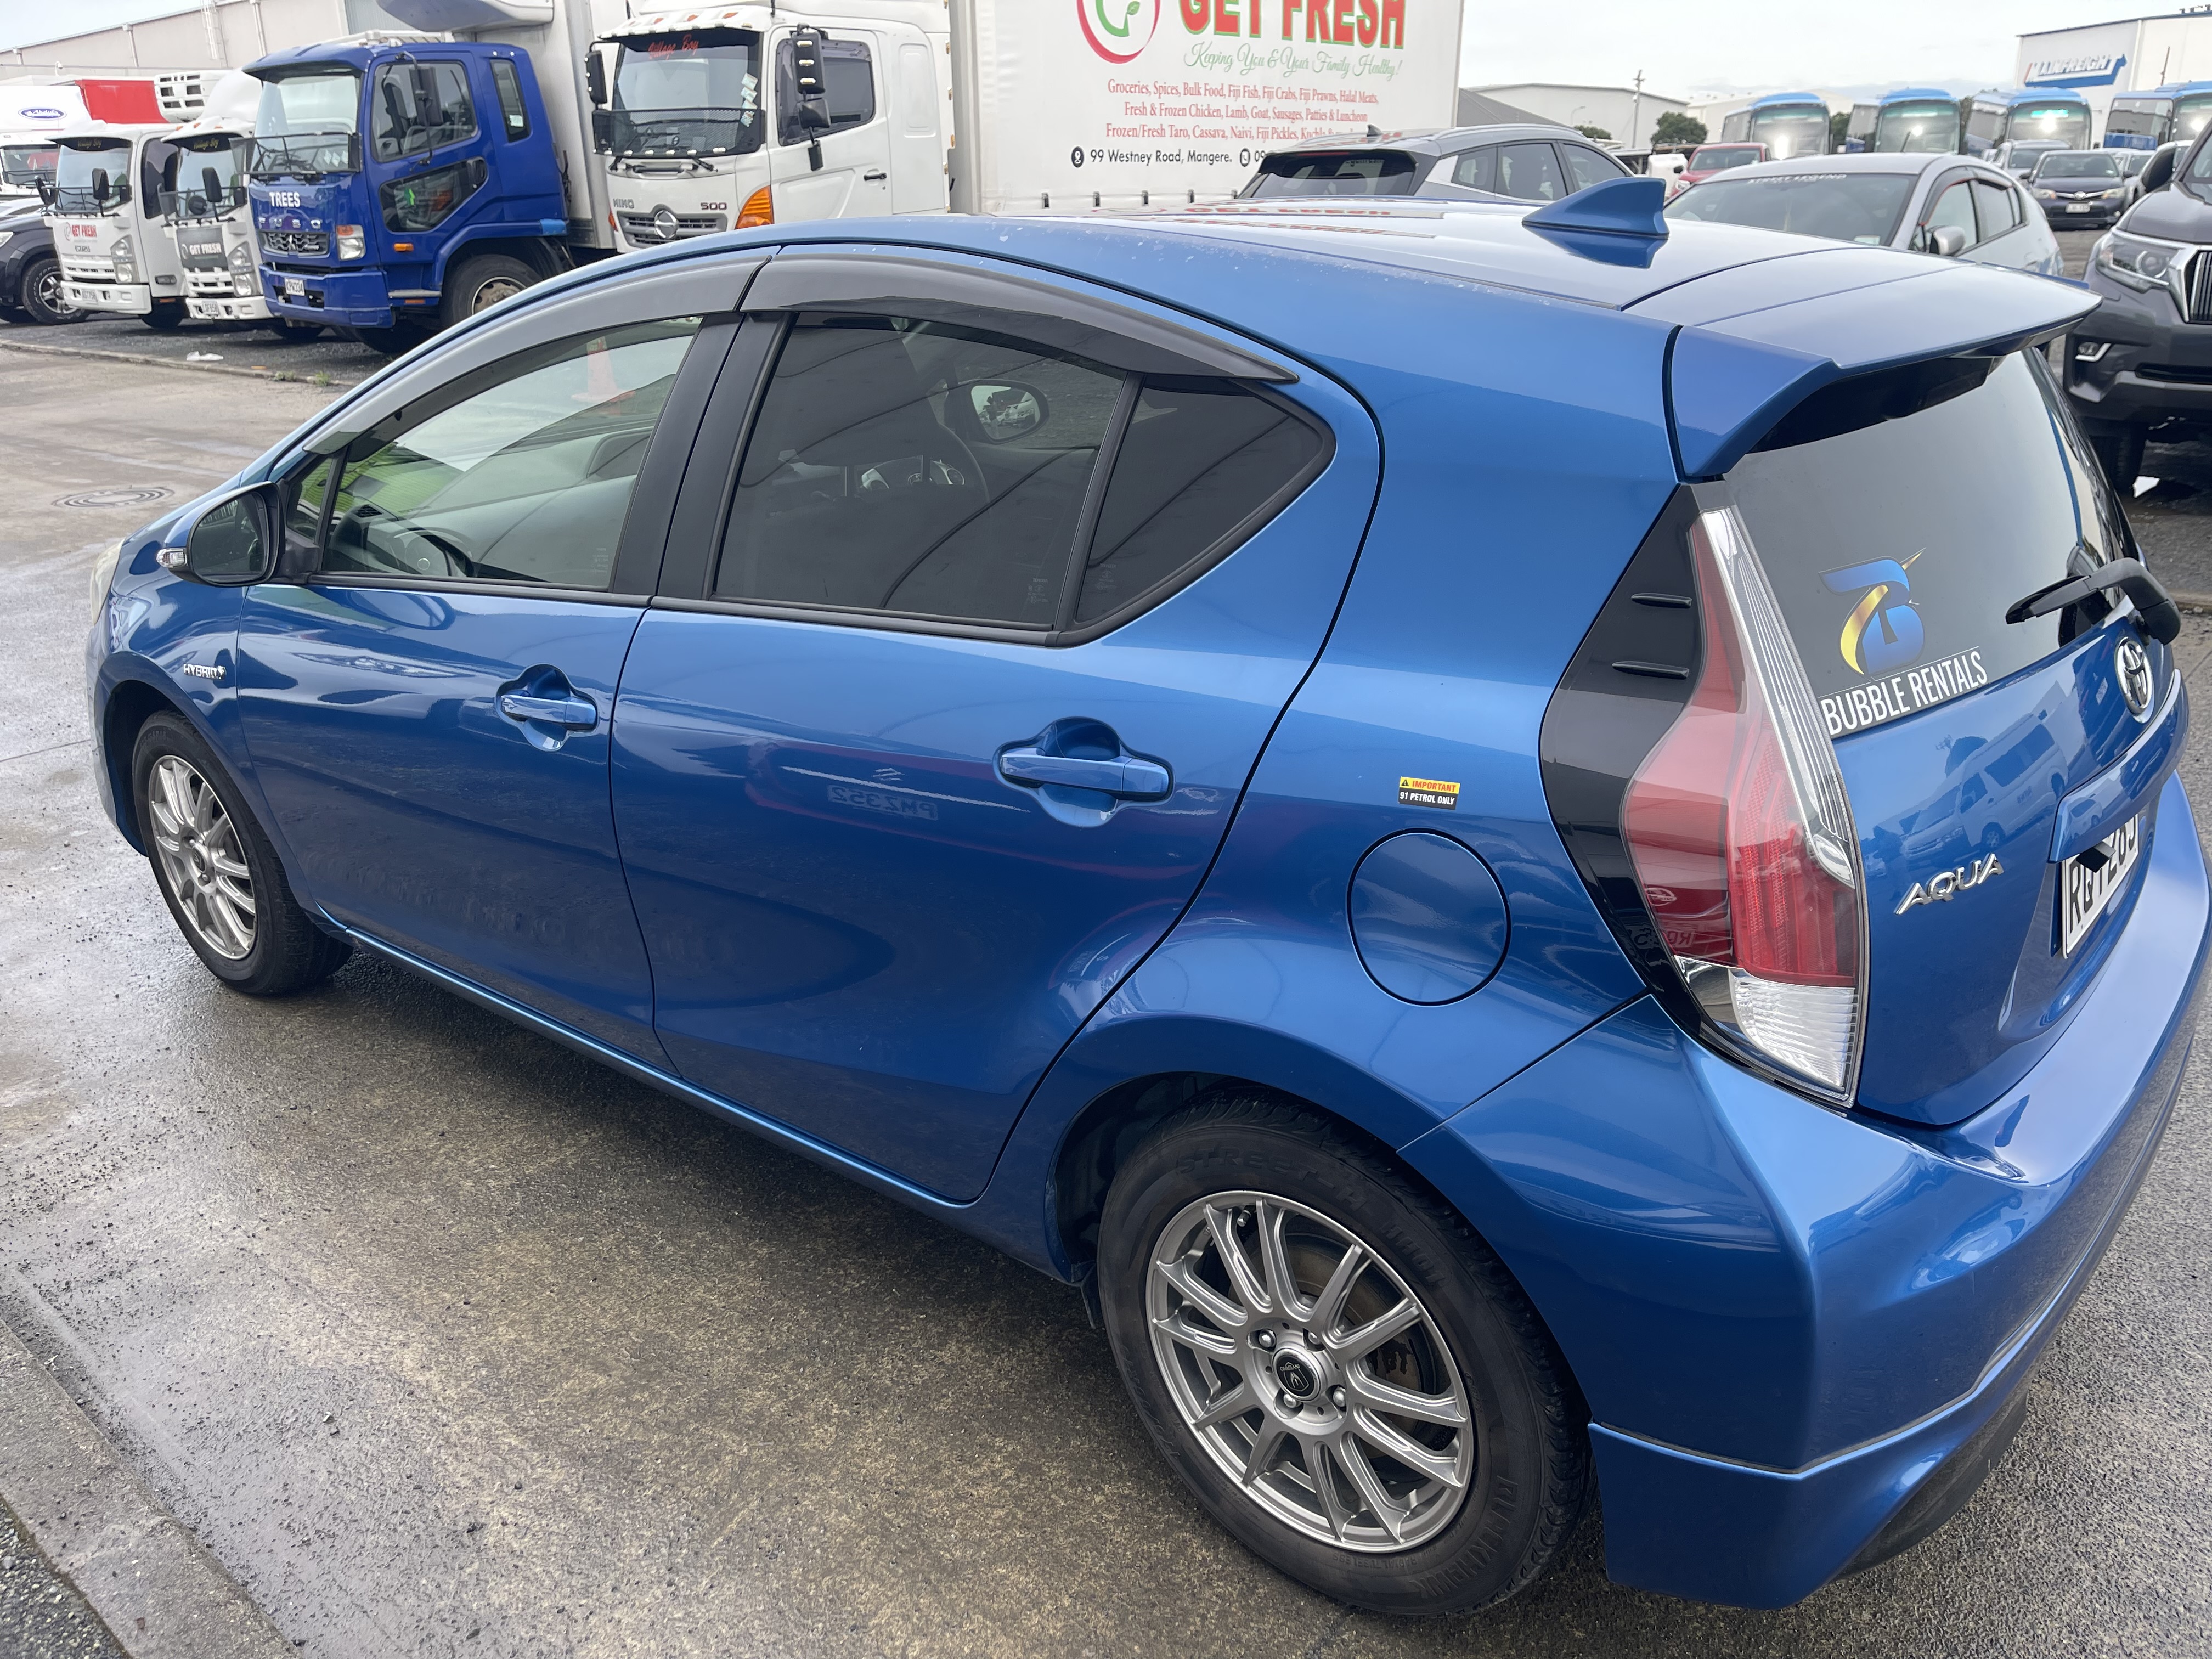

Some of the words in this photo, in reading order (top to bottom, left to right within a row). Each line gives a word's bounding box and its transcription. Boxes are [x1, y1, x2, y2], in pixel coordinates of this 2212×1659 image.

[1282, 0, 1406, 49] FRESH
[1184, 41, 1233, 72] Keeping
[1237, 43, 1264, 75] You
[1267, 49, 1279, 68] &
[1280, 46, 1308, 77] Your
[1312, 51, 1351, 79] Family
[1108, 78, 1152, 96] Groceries,
[1153, 81, 1181, 99] Spices,
[1183, 82, 1203, 96] Bulk
[1204, 83, 1226, 98] Food,
[1228, 84, 1241, 101] Fiji
[1243, 84, 1261, 100] Fish,
[1263, 86, 1274, 103] Fiji
[1275, 87, 1297, 101] Crabs,
[1299, 88, 1311, 104] Fiji
[1340, 90, 1357, 103] Halal
[1125, 101, 1147, 116] Fresh
[1150, 103, 1158, 116] &
[1159, 103, 1187, 116] Frozen
[1189, 104, 1224, 119] Chicken,
[1226, 105, 1249, 119] Lamb,
[1251, 105, 1271, 120] Goat,
[1272, 106, 1304, 123] Sausages,
[1306, 108, 1328, 121] Patties
[1329, 109, 1335, 121] &
[1336, 109, 1368, 122] Luncheon
[1106, 123, 1166, 138] Frozen/Fresh
[1168, 124, 1190, 139] Taro,
[1193, 125, 1228, 140] Cassava,
[1257, 127, 1269, 143] Fiji
[1271, 127, 1299, 140] Pickles,
[1090, 149, 1104, 162] 99
[1108, 149, 1152, 166] Westney
[1155, 149, 1184, 165] Road,
[1187, 150, 1232, 165] Mangere.
[269, 191, 301, 207] TREES
[613, 198, 635, 209] HINO
[701, 202, 727, 210] 500
[72, 224, 81, 237] GET
[81, 225, 98, 238] FRESH
[189, 244, 201, 255] GET
[201, 242, 222, 255] FRESH
[183, 664, 218, 679] HYBRID
[1820, 677, 1910, 736] BUBBLE
[1908, 651, 1988, 707] RENTALS
[1412, 780, 1457, 792] IMPORTANT
[1400, 792, 1409, 800] 91
[1410, 793, 1436, 803] PETROL
[1437, 795, 1455, 805] ONLY
[1894, 853, 2004, 915] AQUA
